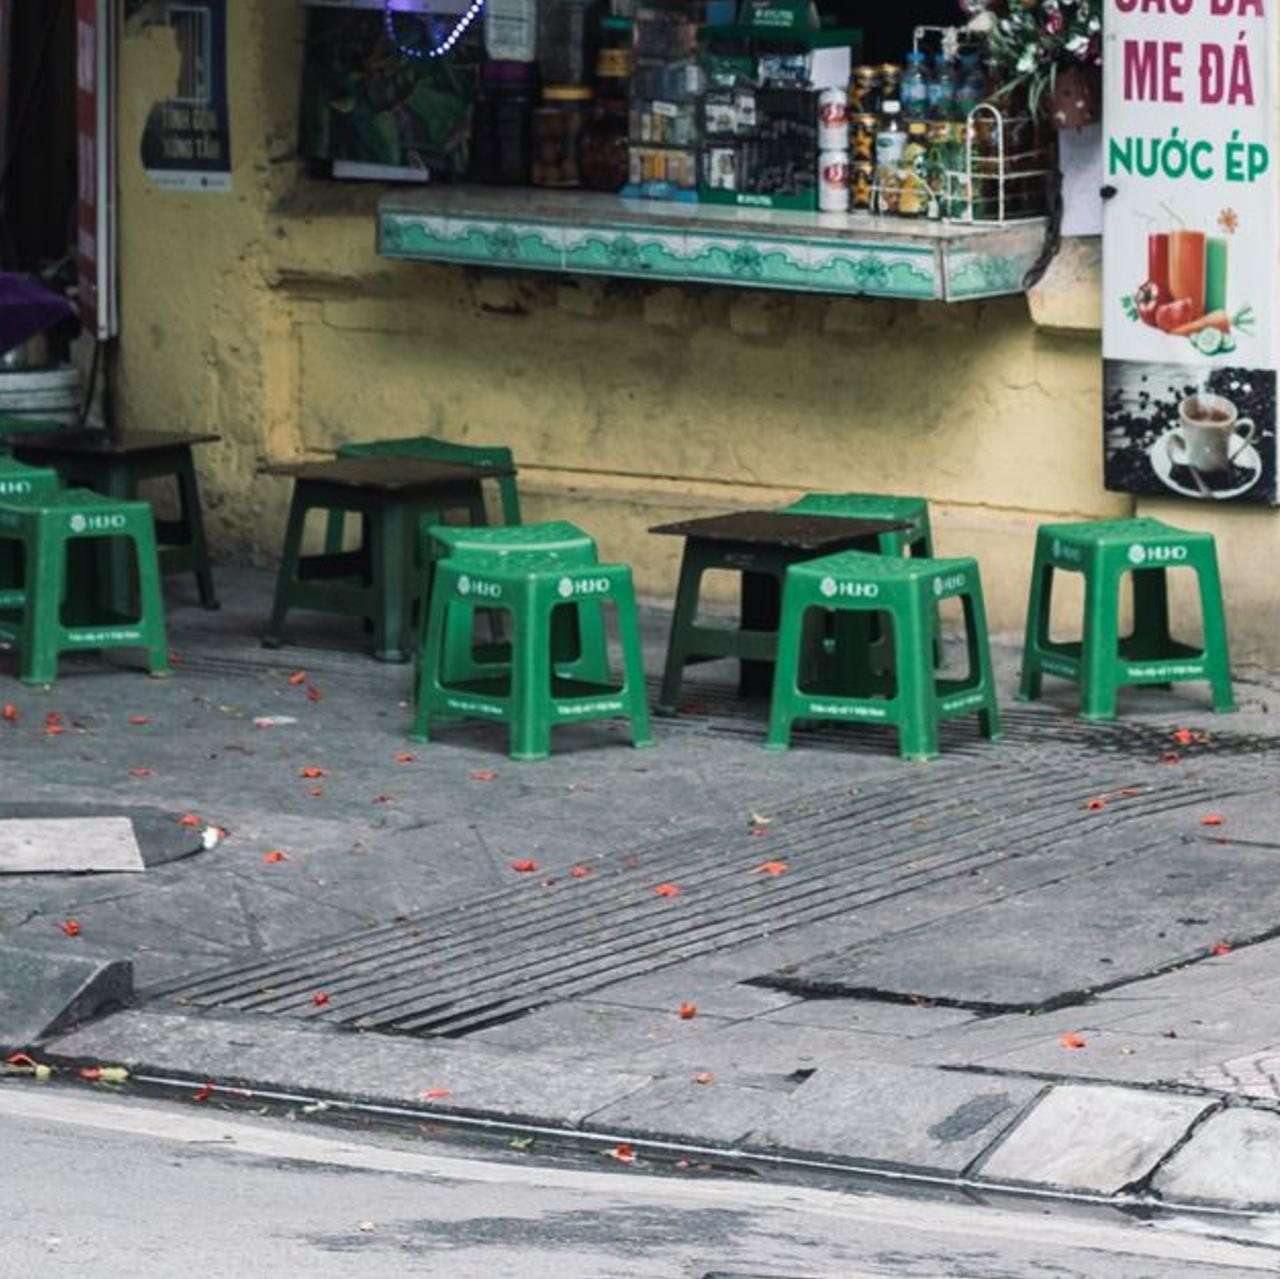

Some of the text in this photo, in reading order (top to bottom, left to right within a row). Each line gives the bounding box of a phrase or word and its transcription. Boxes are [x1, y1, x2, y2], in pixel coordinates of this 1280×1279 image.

[1123, 30, 1255, 107] ME ĐÁ
[1109, 127, 1270, 182] NƯỚC ÉP
